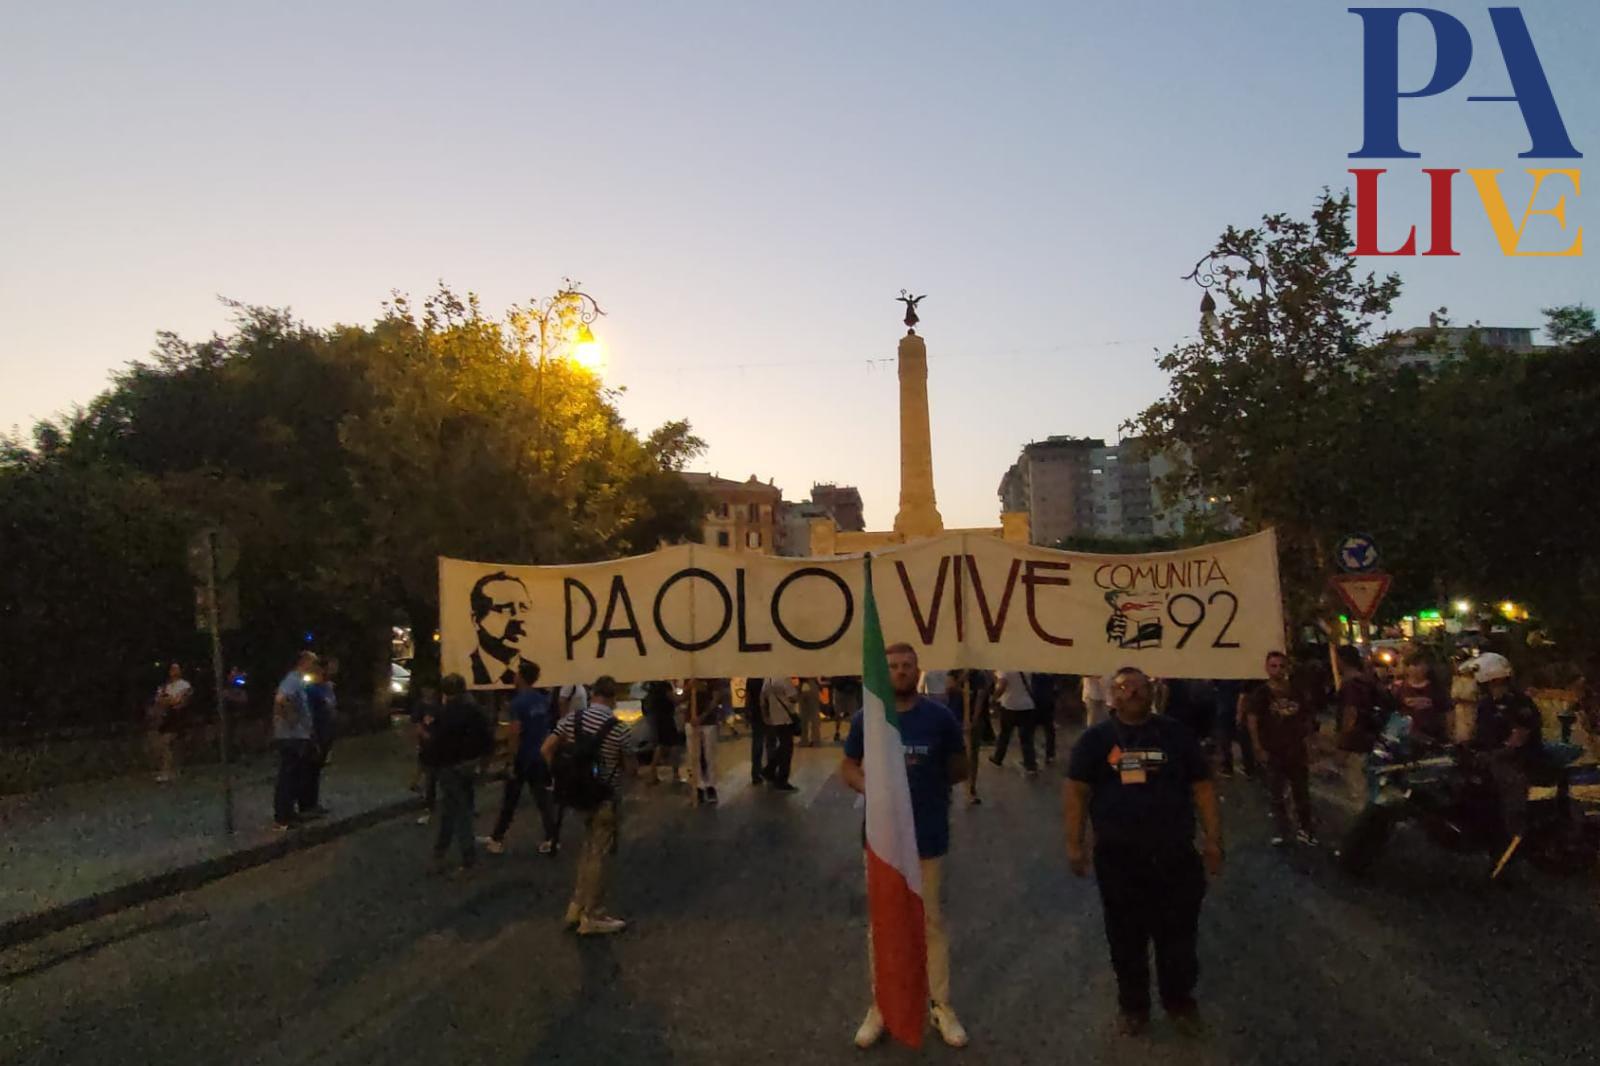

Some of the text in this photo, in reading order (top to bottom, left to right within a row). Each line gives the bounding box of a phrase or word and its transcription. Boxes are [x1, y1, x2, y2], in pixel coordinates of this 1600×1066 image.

[563, 554, 1073, 661] PAOLO VIVE
[1094, 556, 1230, 590] COMUNITÀ
